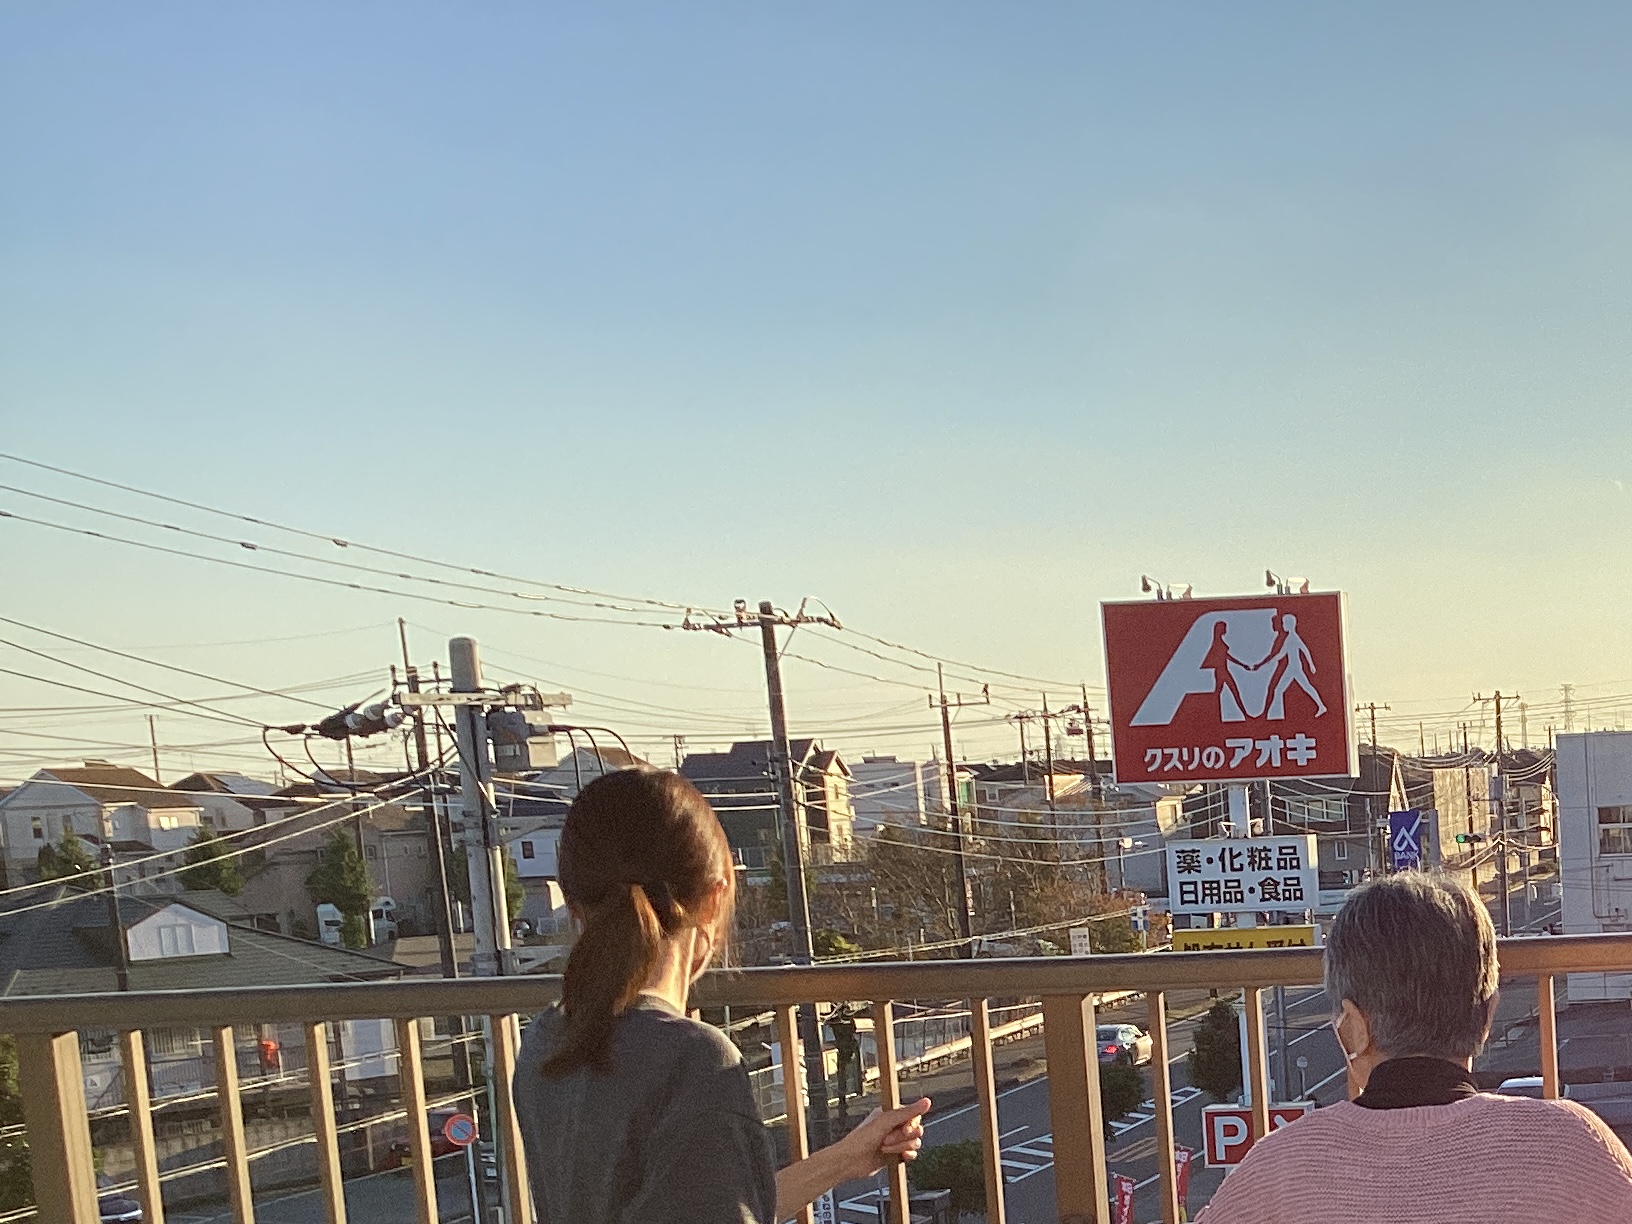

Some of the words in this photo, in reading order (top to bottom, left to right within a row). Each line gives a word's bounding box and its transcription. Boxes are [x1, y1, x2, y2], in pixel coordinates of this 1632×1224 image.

[1144, 733, 1317, 772] クスリのアオキ
[1175, 845, 1302, 874] 薬・化粧品
[1179, 876, 1304, 905] 日用品・食品
[1214, 1116, 1248, 1161] P
